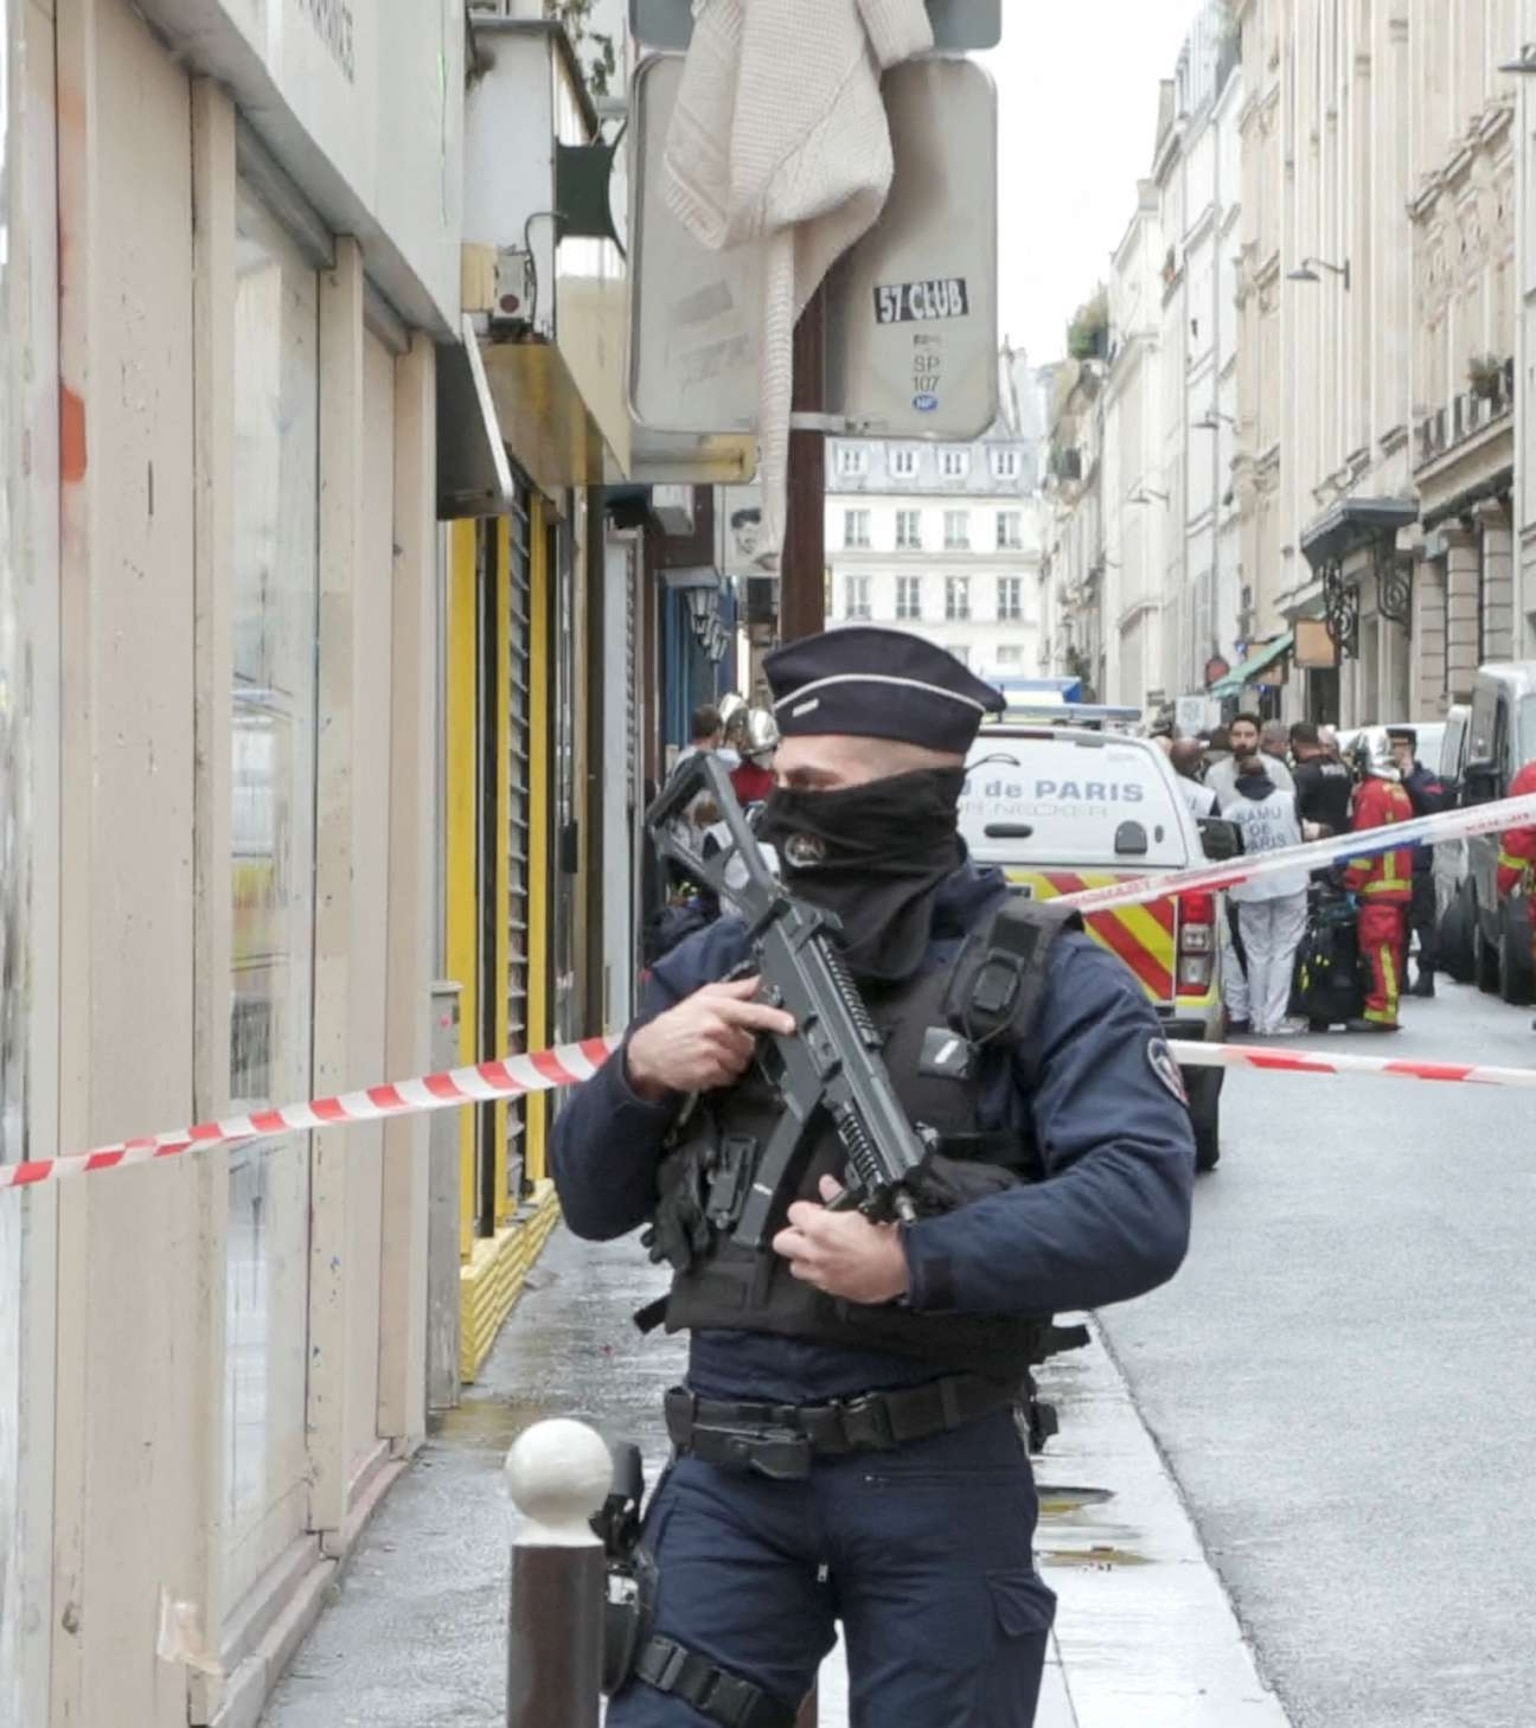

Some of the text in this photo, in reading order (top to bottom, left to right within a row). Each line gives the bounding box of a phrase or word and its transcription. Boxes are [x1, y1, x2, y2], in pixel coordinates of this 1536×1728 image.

[881, 280, 962, 322] 57 CLUB
[914, 355, 940, 372] SP
[914, 376, 940, 392] 107
[985, 780, 1021, 798] de
[1035, 780, 1144, 803] PARIS
